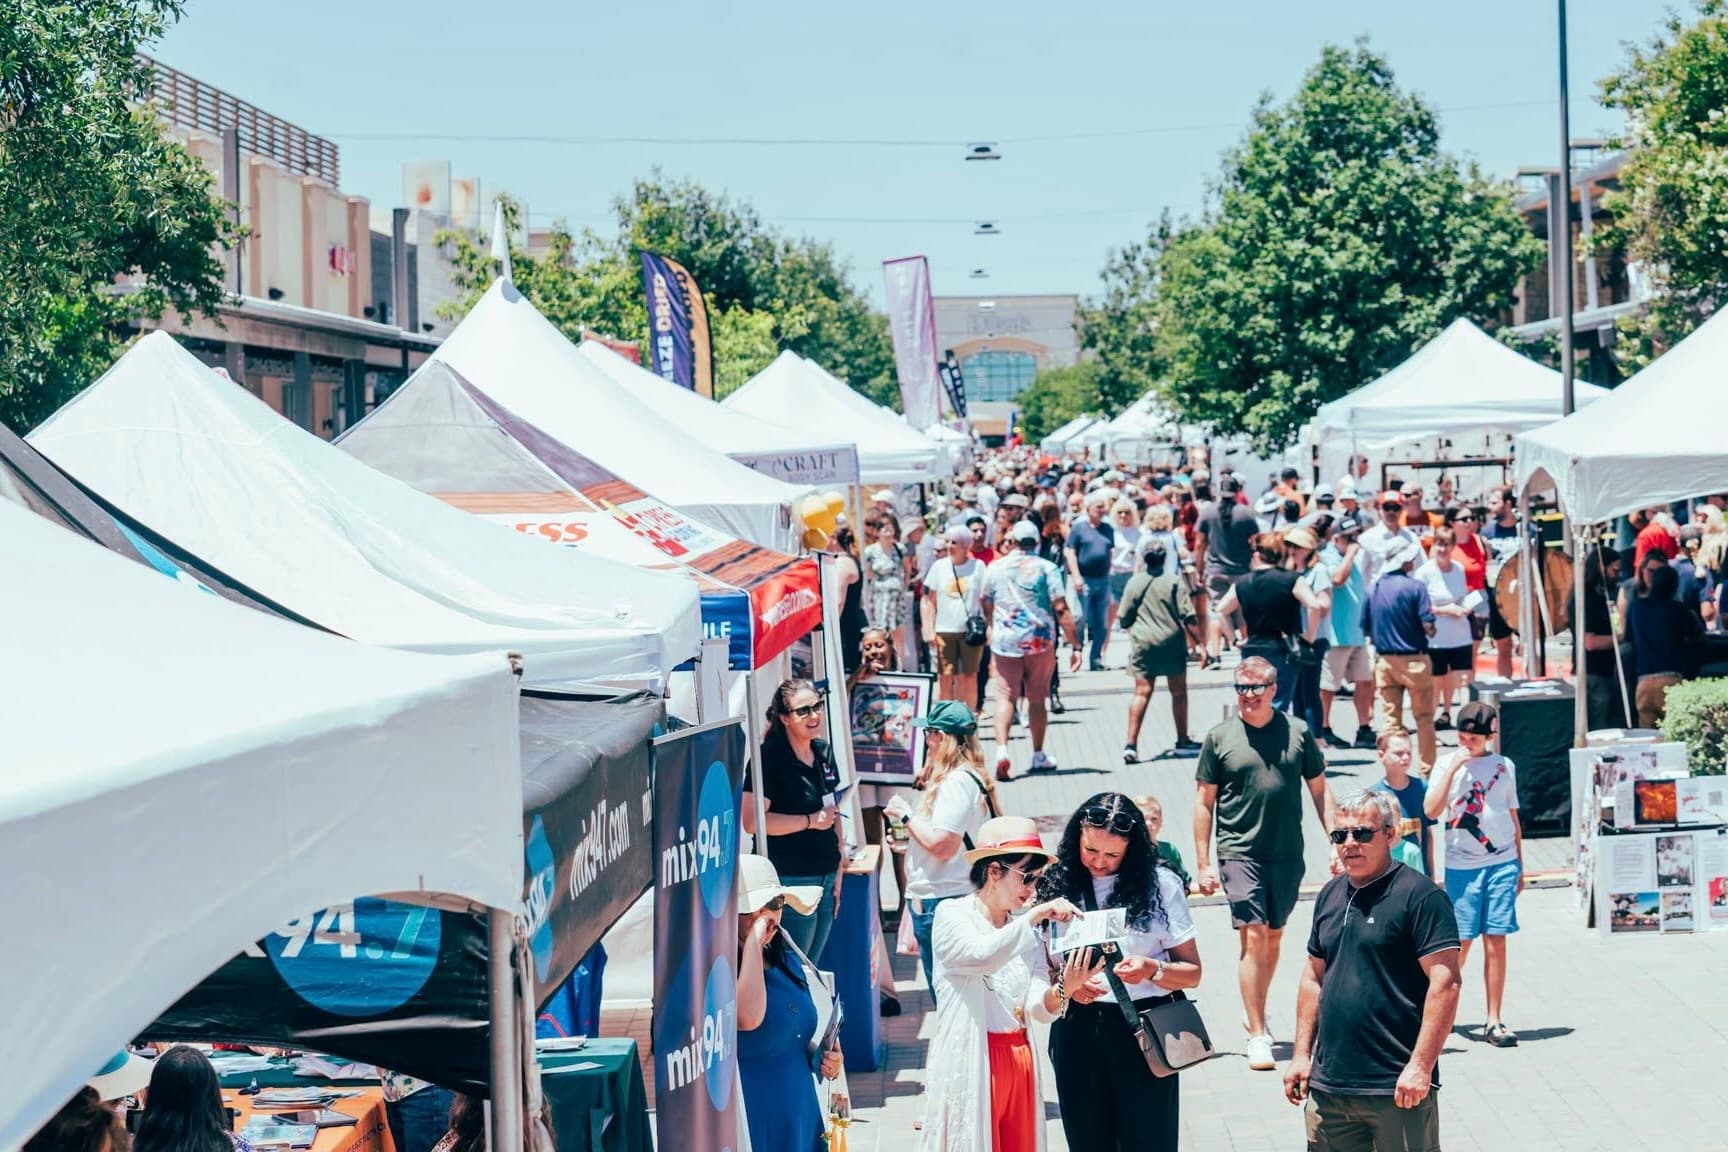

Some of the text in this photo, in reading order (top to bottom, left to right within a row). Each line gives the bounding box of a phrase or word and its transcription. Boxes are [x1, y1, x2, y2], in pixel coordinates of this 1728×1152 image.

[783, 452, 839, 472] CRAFT
[570, 799, 630, 900] mix947.com
[662, 809, 734, 888] mix94.7
[246, 897, 429, 959] 94.7
[666, 1000, 736, 1092] mix94.7
